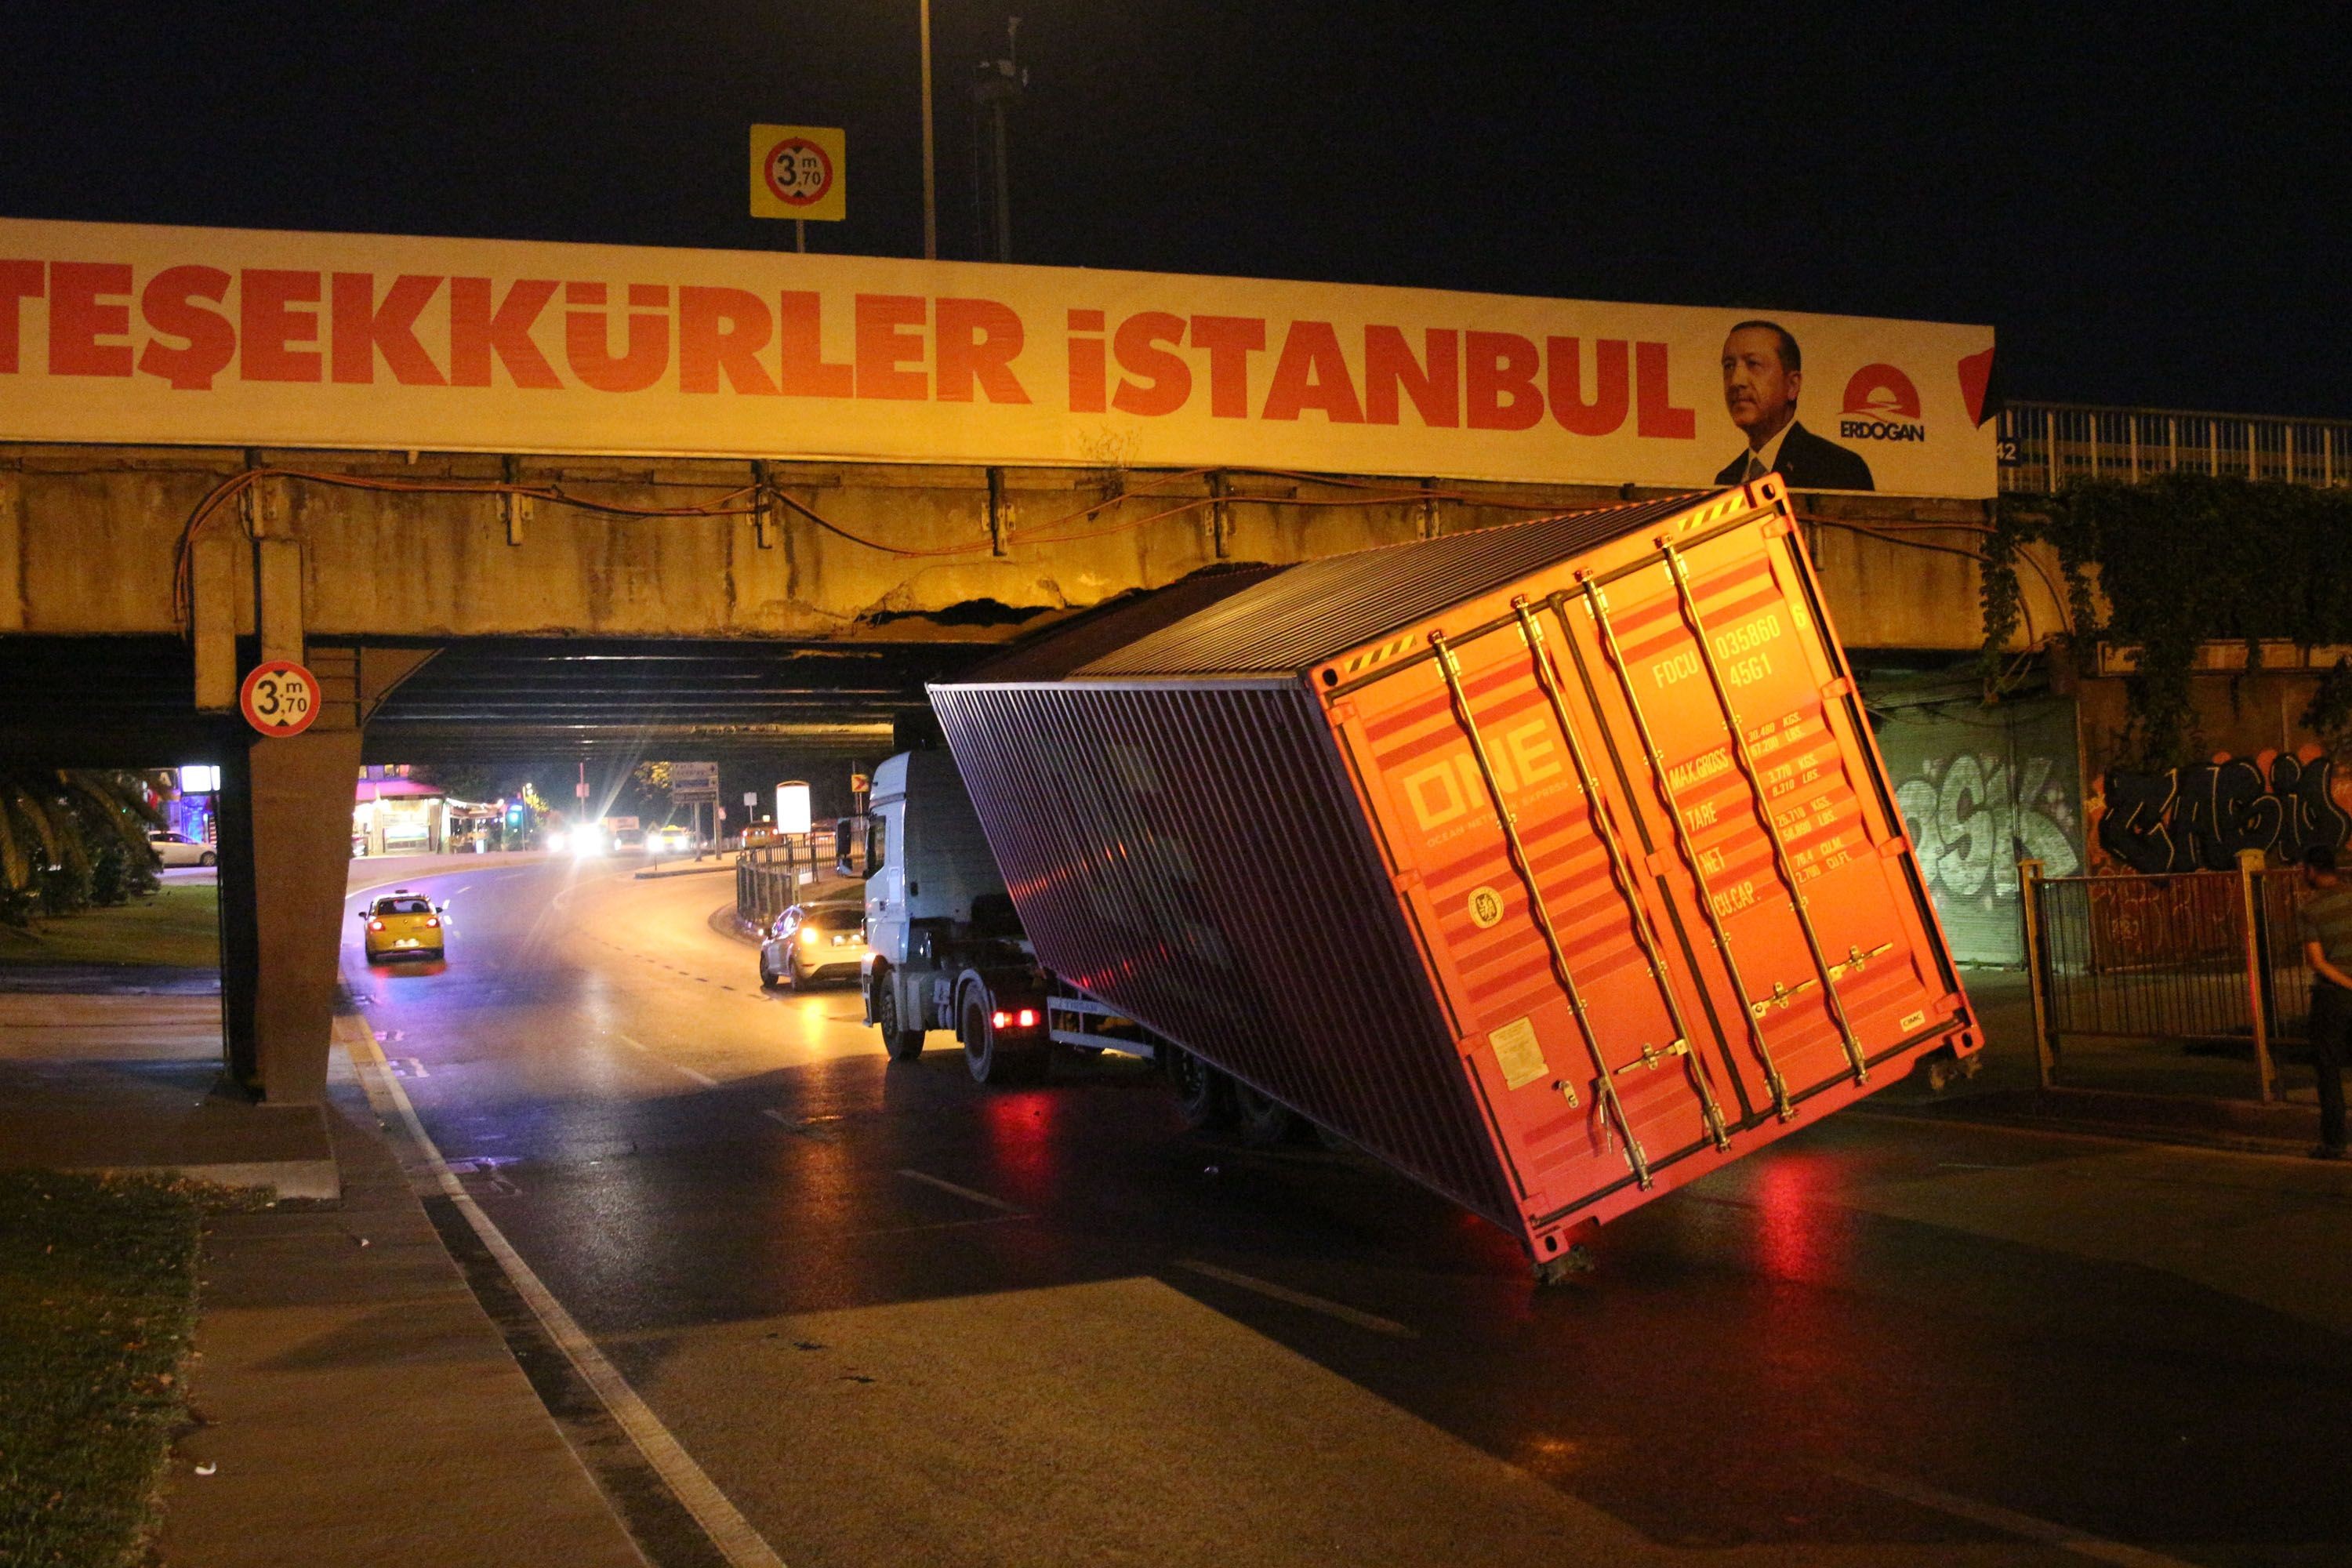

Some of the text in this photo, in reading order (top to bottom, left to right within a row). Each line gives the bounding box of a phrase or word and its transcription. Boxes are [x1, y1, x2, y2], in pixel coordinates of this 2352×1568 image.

[1652, 604, 1807, 688] FDCU 035860 6
[1730, 652, 1772, 688] 45G1
[1783, 712, 1802, 728] KGS.
[1403, 718, 1563, 832] ONE
[1669, 747, 1729, 790] MAX.GROSS
[1798, 753, 1818, 770] KGS.
[1802, 768, 1820, 784] LBS.
[1686, 802, 1718, 832] TARE
[1699, 847, 1726, 876] NET
